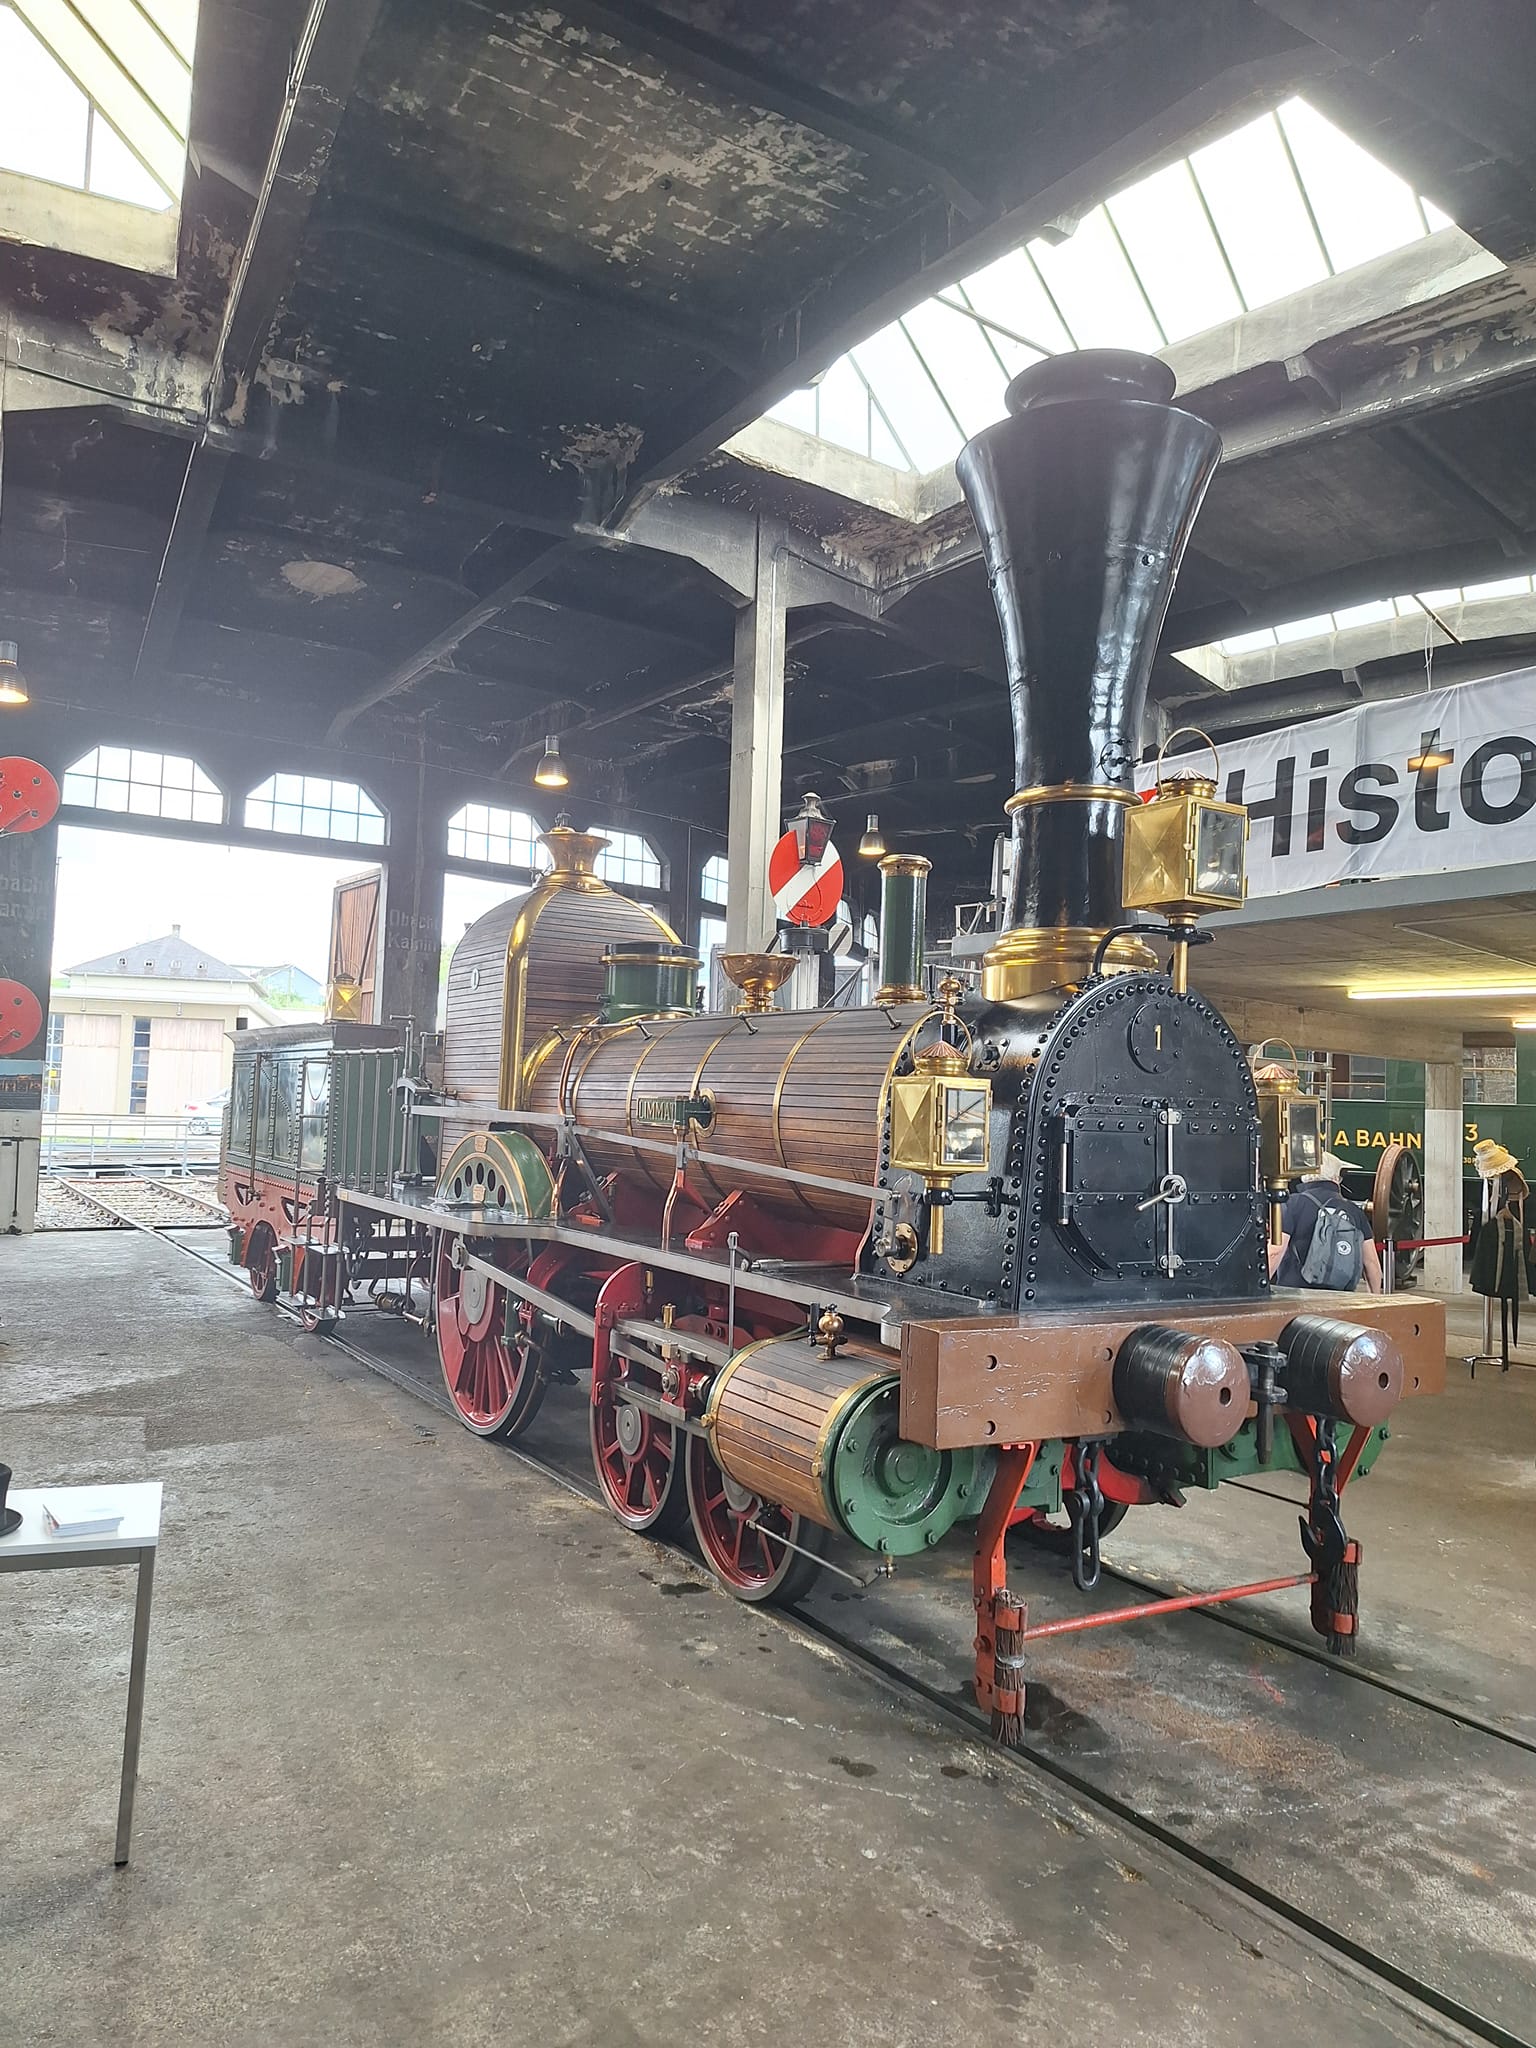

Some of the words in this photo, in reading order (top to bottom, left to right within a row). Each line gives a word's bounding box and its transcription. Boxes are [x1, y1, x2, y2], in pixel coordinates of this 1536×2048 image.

[1225, 728, 1536, 857] Histo
[1154, 1024, 1161, 1050] 1
[1356, 1129, 1422, 1149] BAHN
[1465, 1123, 1478, 1142] 3
